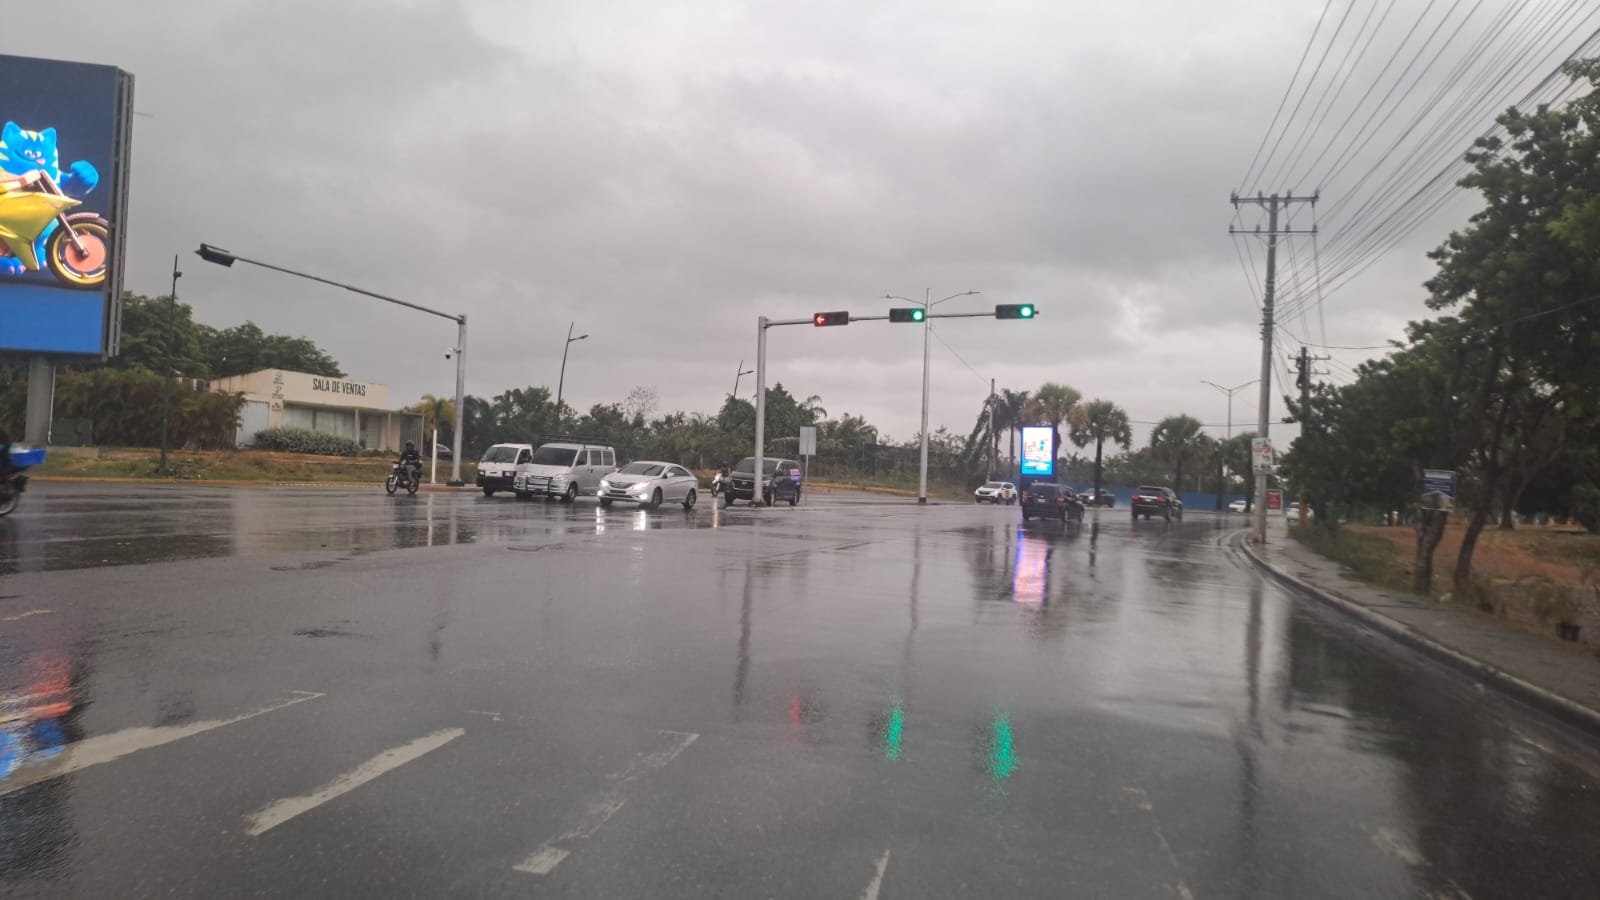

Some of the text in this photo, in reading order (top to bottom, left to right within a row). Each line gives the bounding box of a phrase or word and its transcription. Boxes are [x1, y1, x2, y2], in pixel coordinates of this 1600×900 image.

[313, 378, 366, 396] SALA DE VENTAS
